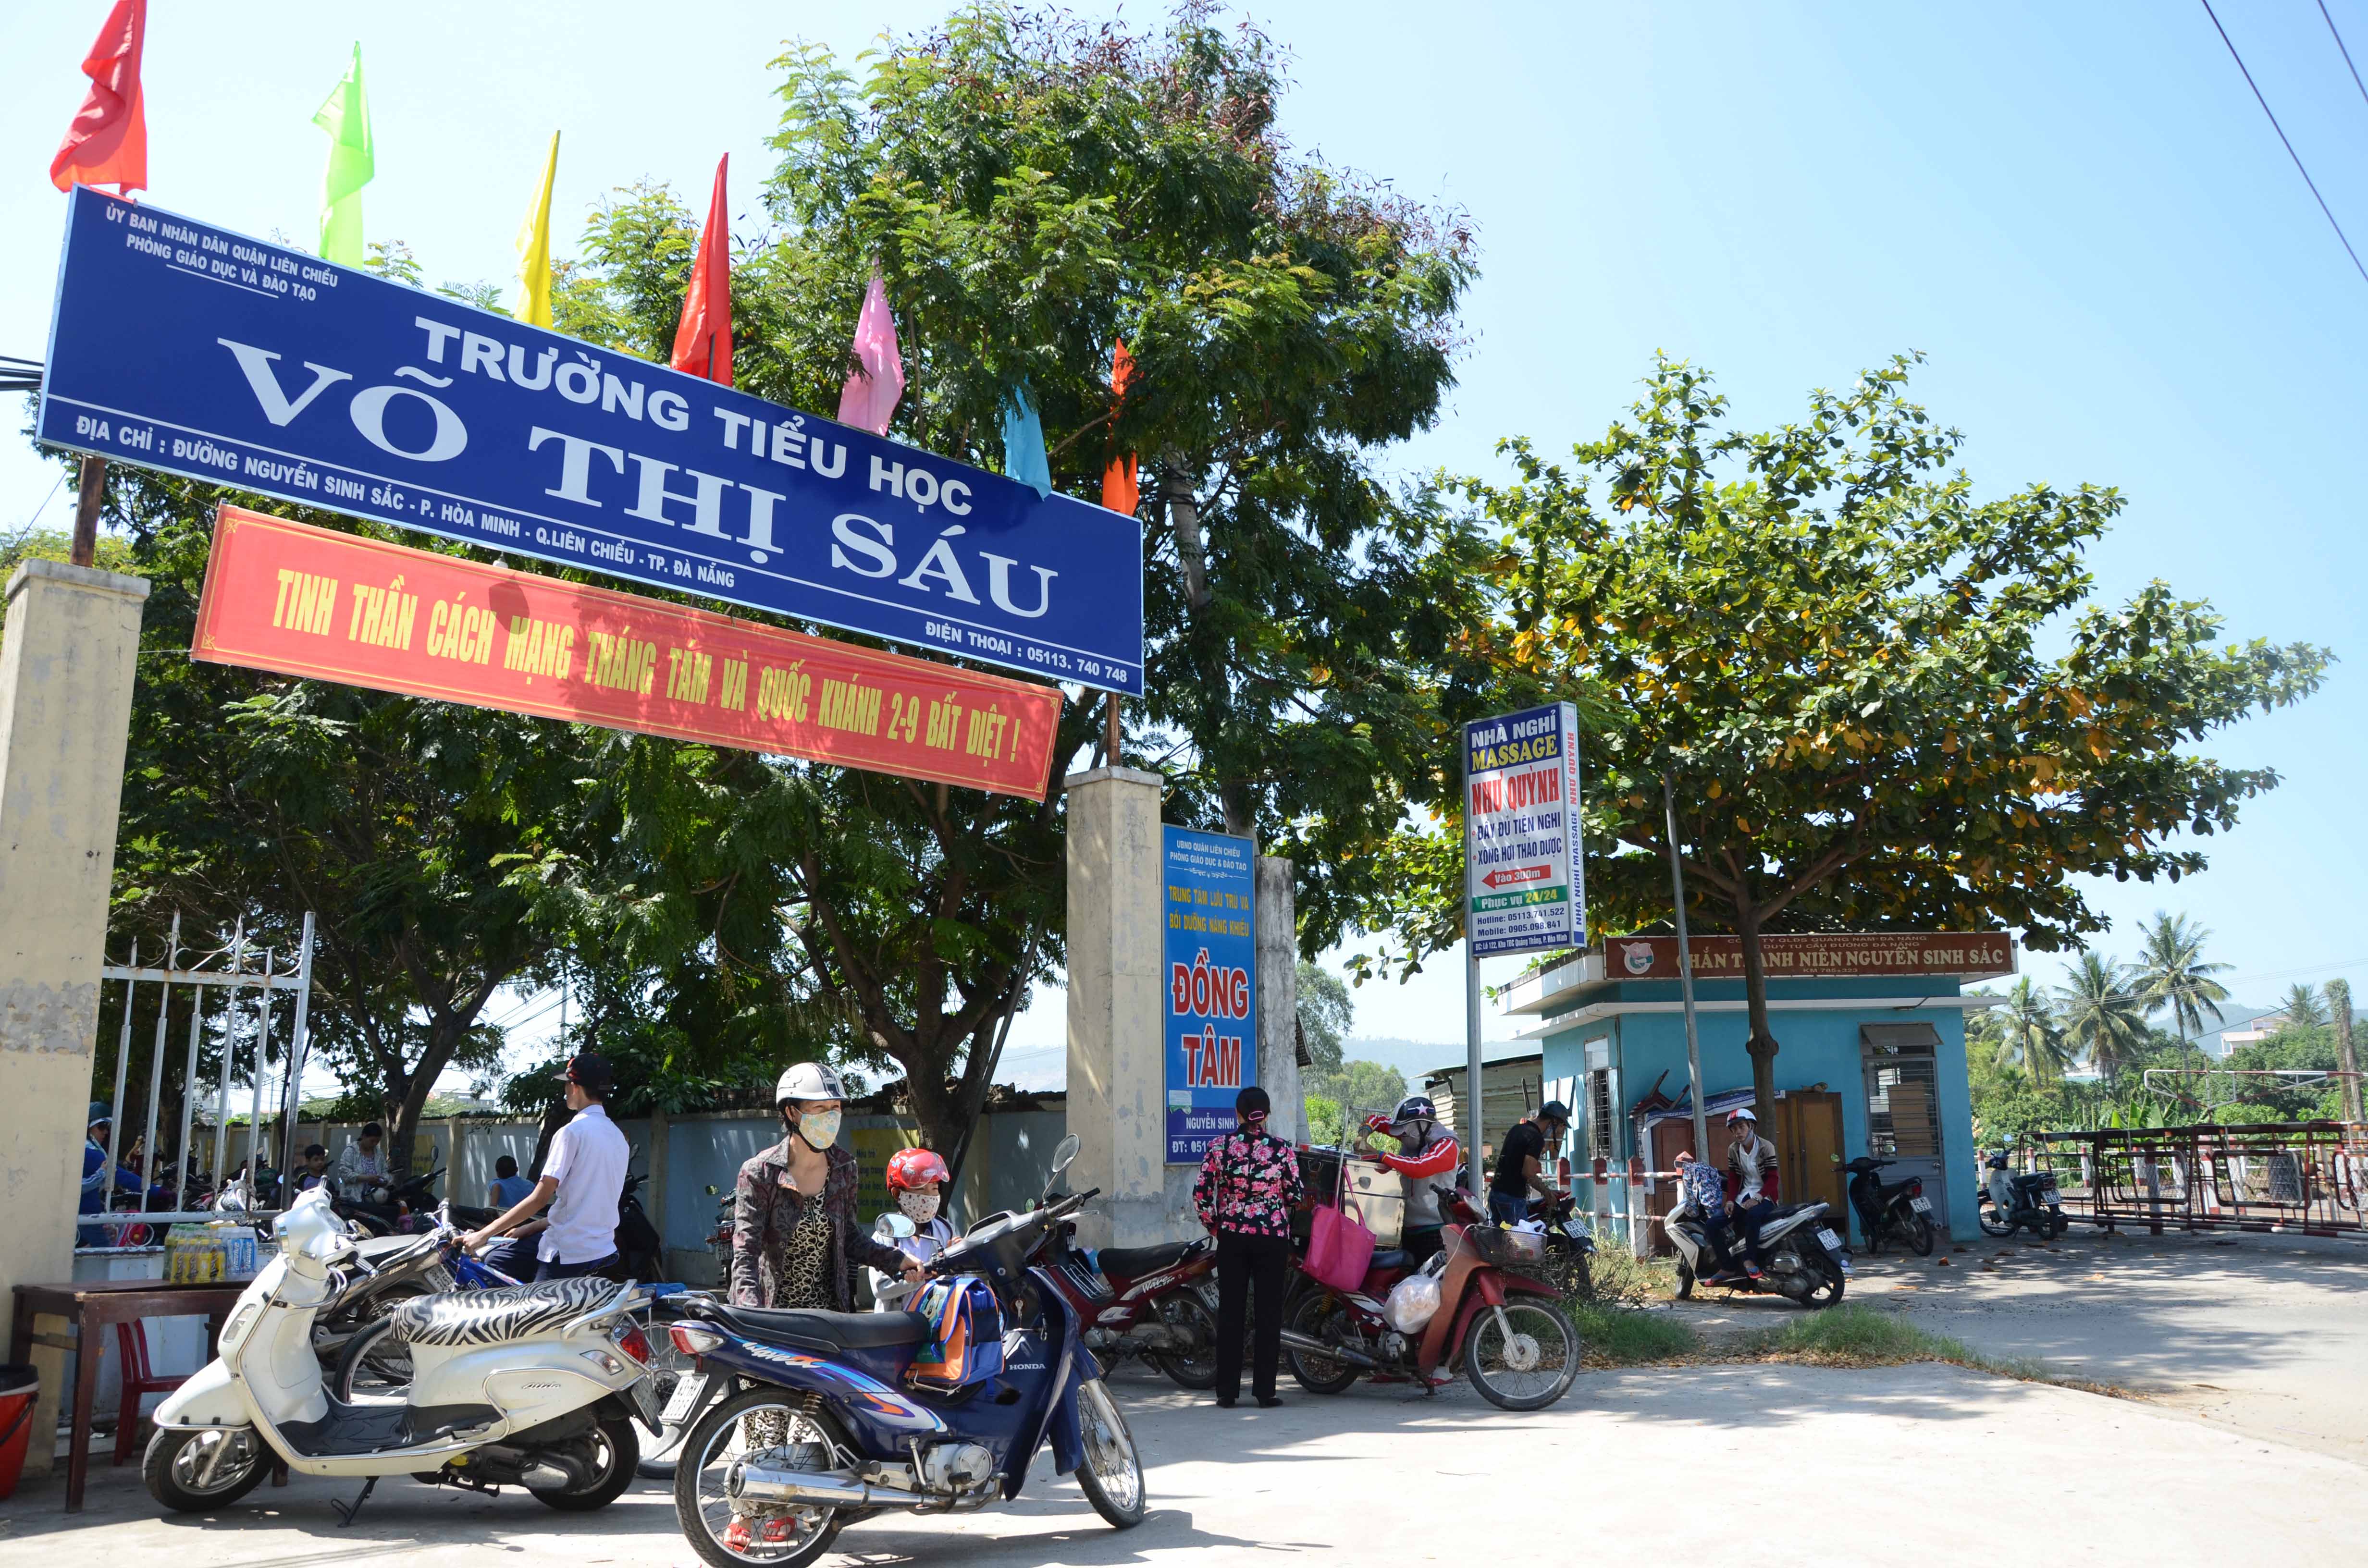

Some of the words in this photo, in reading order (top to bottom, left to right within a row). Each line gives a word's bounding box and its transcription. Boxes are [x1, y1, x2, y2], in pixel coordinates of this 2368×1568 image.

[106, 202, 126, 223] ỦY
[129, 212, 158, 234] BAN
[161, 222, 198, 246] NHÂN
[201, 235, 229, 256] DÂN
[232, 245, 267, 267] QUẬN
[270, 256, 299, 276] LIÊN
[302, 266, 338, 288] CHIỂU
[126, 233, 172, 259] PHÒNG
[175, 249, 208, 270] GIÁO
[211, 259, 238, 281] DỤC
[241, 268, 258, 285] VÀ
[262, 273, 288, 293] ĐÀO
[292, 282, 317, 301] TẠO
[415, 316, 690, 431] TRƯỜNG
[714, 406, 847, 479] TIỂU
[869, 454, 973, 516] HỌC
[217, 337, 468, 462] VÕ
[528, 425, 787, 564] THỊ
[831, 513, 1059, 618] SÁU
[76, 415, 111, 441] ĐỊA
[119, 426, 154, 451] CHỈ
[172, 438, 238, 470] ĐƯỜNG
[244, 456, 319, 490] NGUYỄN
[324, 476, 365, 502] SINH
[370, 483, 405, 510] SẮC
[420, 499, 435, 518] P.
[441, 502, 475, 527] HÒA
[481, 513, 520, 538] MINH
[535, 527, 586, 553] Q.LIÊN
[590, 539, 635, 564] CHIỂU
[647, 553, 668, 573] TP.
[673, 558, 692, 579] ĐÀ
[697, 562, 735, 588] NẴNG
[925, 621, 962, 643] ĐIỆN
[967, 631, 1012, 655] THOẠI
[1027, 646, 1072, 670] 05113.
[1076, 658, 1100, 676] 740
[1104, 665, 1127, 683] 748
[272, 569, 338, 636] TINH
[349, 575, 418, 650] THẦN
[427, 591, 496, 665] CÁCH
[504, 615, 574, 685] MẠNG
[584, 626, 656, 695] THÁNG
[666, 639, 712, 708] TÁM
[722, 649, 748, 711] VÀ
[757, 658, 811, 723] QUỐC
[817, 673, 882, 736] KHÁNH
[888, 698, 920, 743] 2-9
[926, 691, 962, 751] BẤT
[966, 704, 1008, 767] DIỆT
[1472, 723, 1508, 748] NHÀ
[1513, 709, 1556, 739] NGHỈ
[1472, 734, 1557, 771] MASSAGE
[1566, 732, 1576, 774] QUỲNH
[1472, 770, 1504, 815] NHƯ
[1507, 765, 1559, 812] QUỲNH
[1568, 777, 1577, 805] NHƯ
[1477, 819, 1494, 841] ĐẦY
[1498, 815, 1510, 837] ĐỦ
[1513, 814, 1534, 837] TIỆN
[1538, 811, 1561, 830] NGHI
[1571, 810, 1580, 866] MASSAGE
[1170, 850, 1189, 862] PHÒNG
[1190, 854, 1204, 865] GIÁO
[1205, 857, 1216, 868] DỤC
[1223, 859, 1234, 869] ĐÀO
[1235, 862, 1247, 872] TẠO
[1176, 840, 1192, 850] UBND
[1193, 842, 1209, 854] QUẬN
[1209, 844, 1222, 855] LIÊN
[1478, 847, 1499, 865] XÔNG
[1502, 844, 1515, 864] HƠI
[1517, 837, 1537, 859] THẢO
[1540, 837, 1562, 858] DƯỢC
[1494, 874, 1512, 883] Vào
[1515, 870, 1541, 881] 300m
[1572, 870, 1580, 897] NGHỈ
[1169, 885, 1192, 903] TRUNG
[1193, 886, 1208, 905] TÂM
[1240, 892, 1250, 911] VÀ
[1481, 898, 1507, 909] Phục
[1510, 895, 1523, 906] vụ
[1525, 889, 1557, 903] 24/24
[1184, 912, 1207, 932] DƯỠNG
[1230, 917, 1250, 937] KHIẾU
[1477, 916, 1506, 925] Hotline:
[1508, 907, 1565, 921] 05113.741.522
[1574, 901, 1582, 925] NHÀ
[1478, 928, 1506, 937] Mobile:
[1509, 920, 1561, 933] 0905.098.841
[1731, 952, 1793, 968] TANH
[1799, 948, 1842, 967] NIÊN
[1846, 945, 1918, 966] NGUYỄN
[1924, 950, 1964, 965] SINH
[1969, 942, 2003, 965] SẮC
[1171, 947, 1249, 1020] ĐỒNG
[1181, 1023, 1242, 1089] TÂM
[1186, 1113, 1216, 1129] NGUYỄN
[1218, 1117, 1234, 1129] SINH
[1172, 1141, 1187, 1153] ĐT:
[1191, 1140, 1207, 1153] 051
